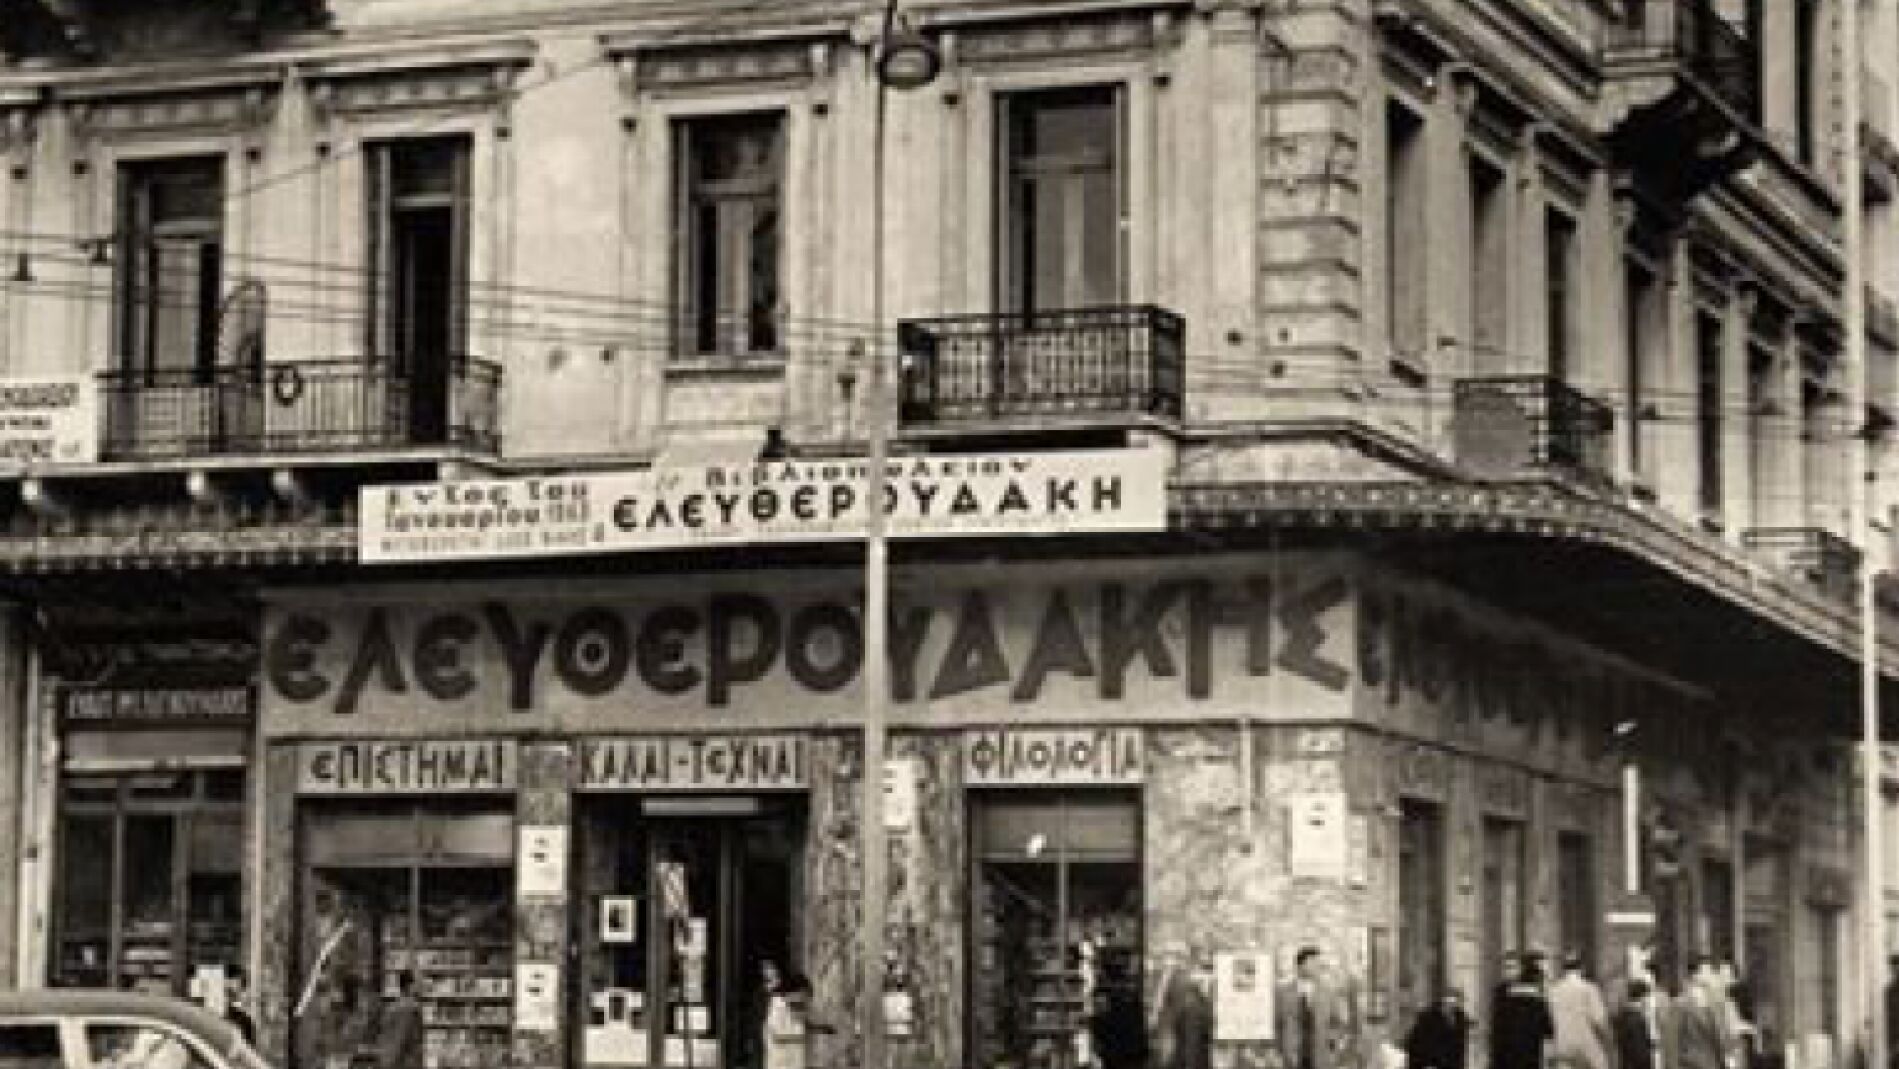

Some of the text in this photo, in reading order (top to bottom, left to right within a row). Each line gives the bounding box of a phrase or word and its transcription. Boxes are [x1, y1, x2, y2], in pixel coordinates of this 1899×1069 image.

[268, 577, 1352, 714] ΕΛΕΥΘΕΡΟΥΔΑΚΗΣ
[310, 744, 503, 788] ΕΠΙΣΤΗΜΑΙ
[971, 730, 1140, 779] ΦΙΛΟΛΟΓΙΑ
